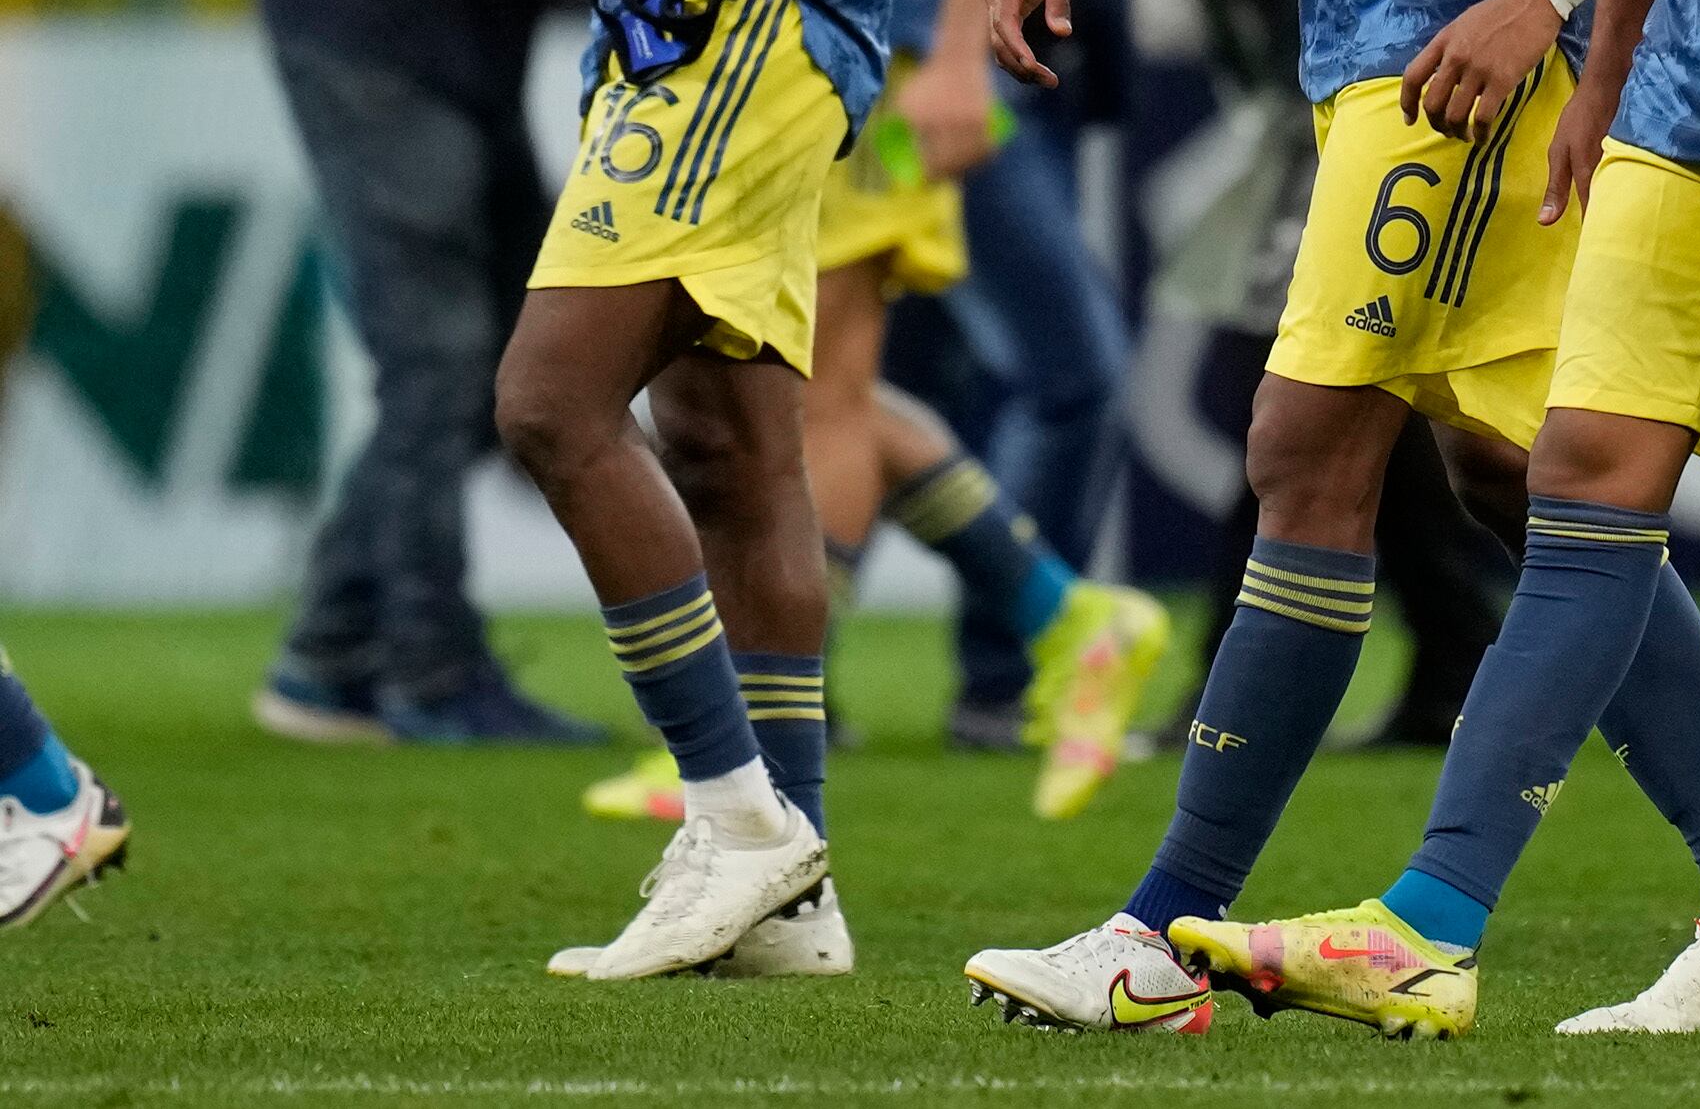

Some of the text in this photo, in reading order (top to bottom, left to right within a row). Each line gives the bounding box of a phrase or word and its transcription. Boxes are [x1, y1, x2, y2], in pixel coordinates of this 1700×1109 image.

[581, 78, 681, 184] 16
[570, 218, 620, 243] adidas
[1365, 162, 1442, 276] 6
[1344, 314, 1397, 338] adidas
